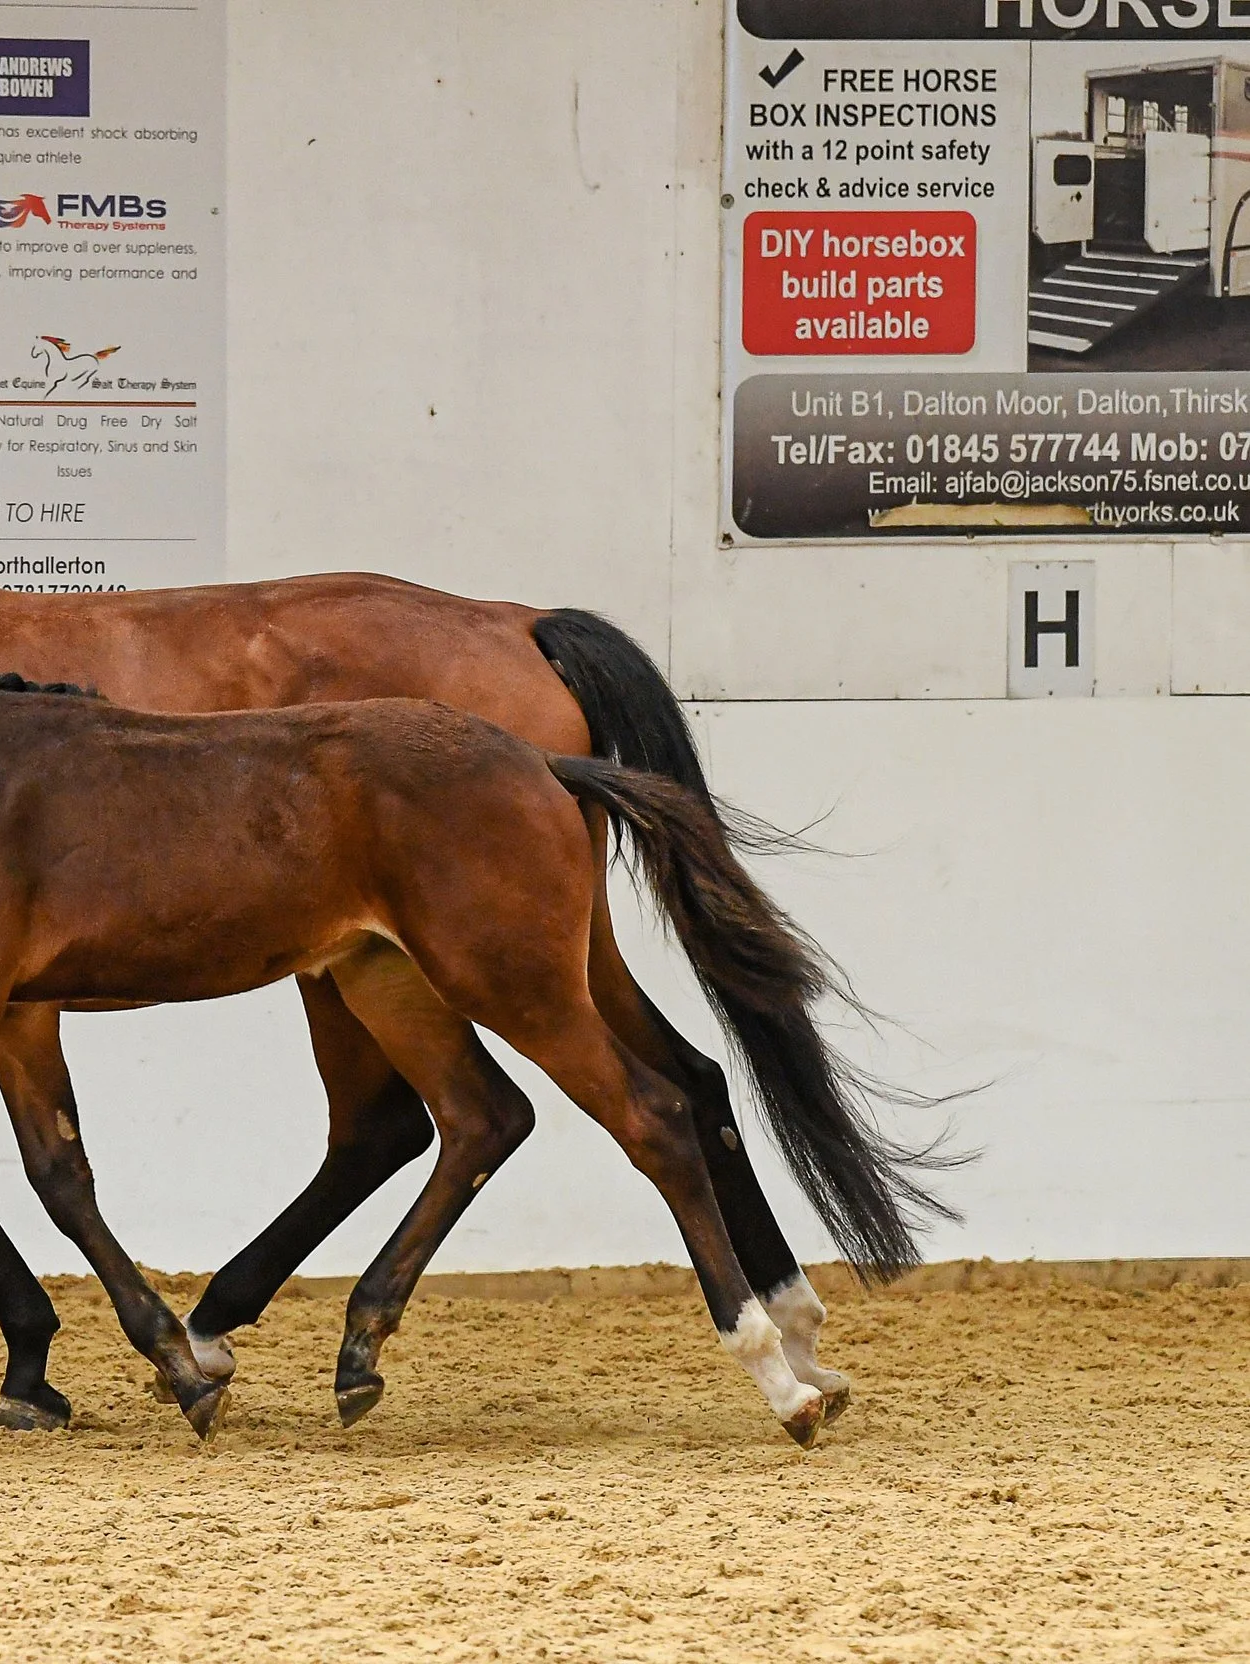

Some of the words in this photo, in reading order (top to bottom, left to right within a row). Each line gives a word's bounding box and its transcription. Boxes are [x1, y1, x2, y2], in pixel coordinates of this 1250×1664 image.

[0, 57, 72, 76] ANDREWS
[0, 79, 53, 97] BOWEN
[824, 69, 893, 92] FREE
[904, 69, 996, 92] HORSE
[751, 104, 806, 127] BOX
[816, 104, 996, 127] INSPECTIONS
[26, 127, 84, 138] excellent
[91, 128, 127, 139] shock
[134, 128, 197, 143] absorbing
[36, 152, 81, 164] athlete
[746, 140, 793, 160] with
[802, 145, 813, 160] a
[823, 140, 846, 160] 12
[856, 140, 914, 165] point
[922, 139, 990, 165] safety
[745, 178, 808, 198] check
[816, 177, 831, 198] &
[839, 177, 909, 198] advice
[917, 177, 994, 198] service
[58, 194, 166, 218] FMBs
[58, 221, 109, 231] Therapy
[113, 222, 165, 231] Systems
[0, 241, 11, 252] to
[17, 243, 68, 254] improve
[74, 241, 88, 253] all
[93, 244, 121, 253] over
[126, 242, 197, 256] suppleness,
[761, 229, 814, 257] DIY
[823, 229, 965, 257] horsebox
[9, 266, 72, 281] improving
[80, 266, 164, 280] performance
[172, 268, 197, 279] and
[783, 270, 856, 298] build
[868, 271, 943, 305] parts
[796, 311, 929, 339] available
[12, 377, 45, 389] Equine
[92, 378, 112, 389] Salt
[118, 378, 156, 391] Therapy
[160, 378, 196, 391] System
[792, 390, 842, 416] Unit
[852, 390, 893, 419] B1,
[904, 390, 986, 415] Dalton
[997, 389, 1067, 418] Moor,
[57, 415, 87, 430] Drug
[101, 415, 127, 427] Free
[142, 415, 162, 429] Dry
[175, 415, 197, 427] Salt
[8, 440, 24, 451] for
[30, 440, 102, 454] Respiratory,
[108, 440, 137, 452] Sinus
[143, 441, 168, 452] and
[174, 440, 197, 452] Skin
[771, 434, 894, 464] Tel/Fax:
[907, 434, 999, 463] 01845
[1010, 432, 1120, 462] 577744
[1131, 432, 1207, 461] Mob:
[870, 471, 937, 493] Email:
[6, 503, 33, 522] TO
[41, 504, 85, 522] HIRE
[1024, 590, 1079, 668] H
